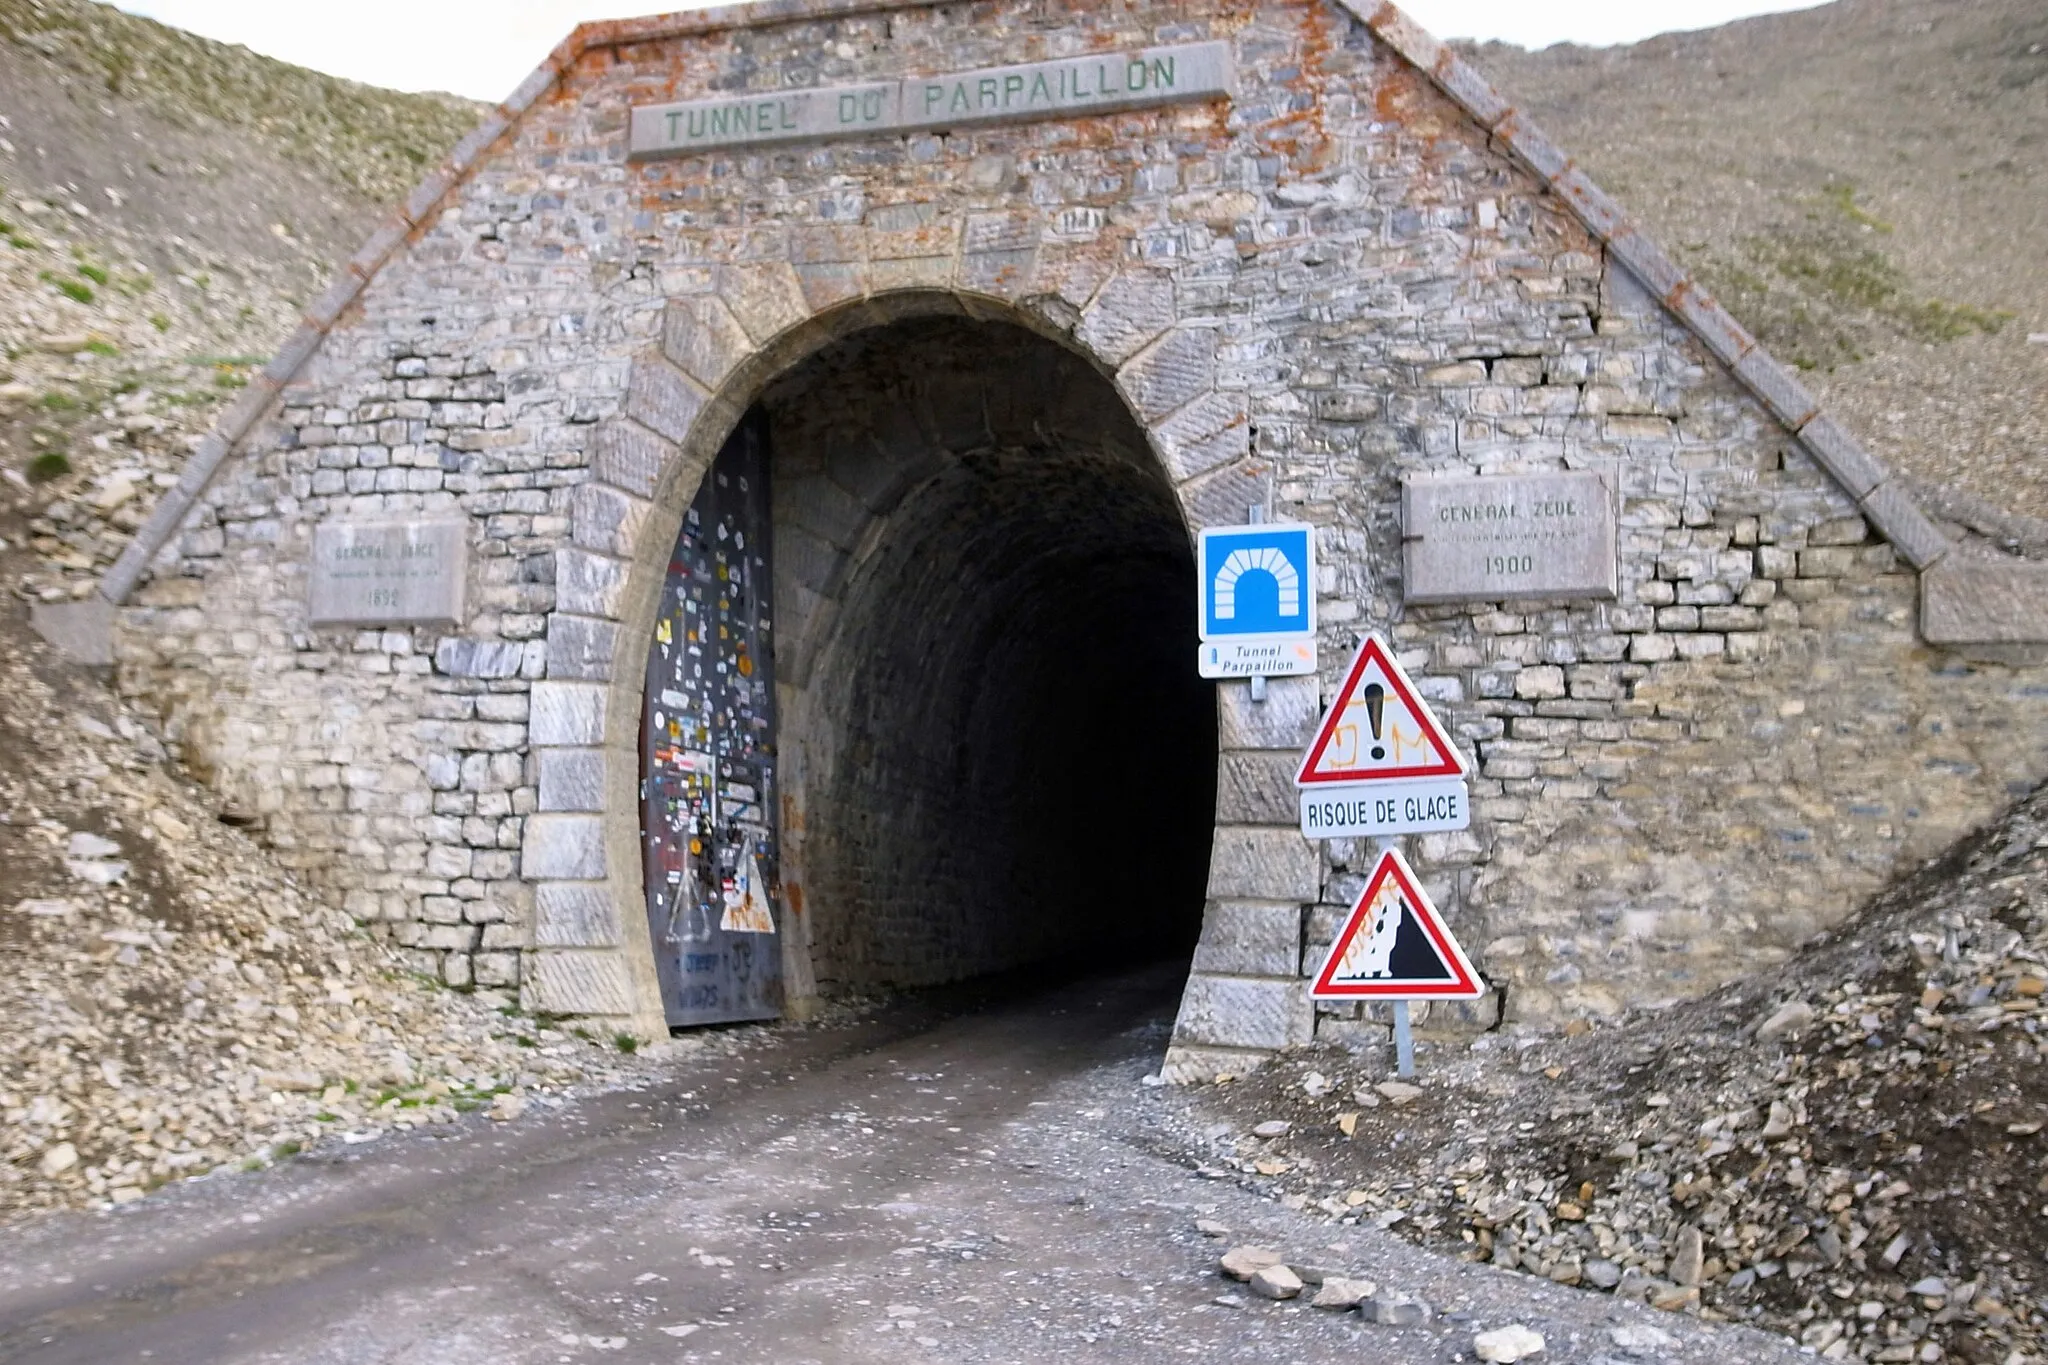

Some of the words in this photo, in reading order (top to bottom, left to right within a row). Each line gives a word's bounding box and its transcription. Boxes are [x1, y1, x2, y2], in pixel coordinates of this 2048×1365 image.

[665, 100, 797, 141] TUNNEL
[923, 55, 1175, 115] PARPAILLON
[1486, 555, 1533, 575] 1900
[1236, 644, 1282, 658] Tunnel
[1222, 659, 1294, 674] Parpaillon
[1308, 801, 1368, 828] RISQUE
[1376, 799, 1397, 823] DE
[1405, 795, 1458, 822] GLACE
